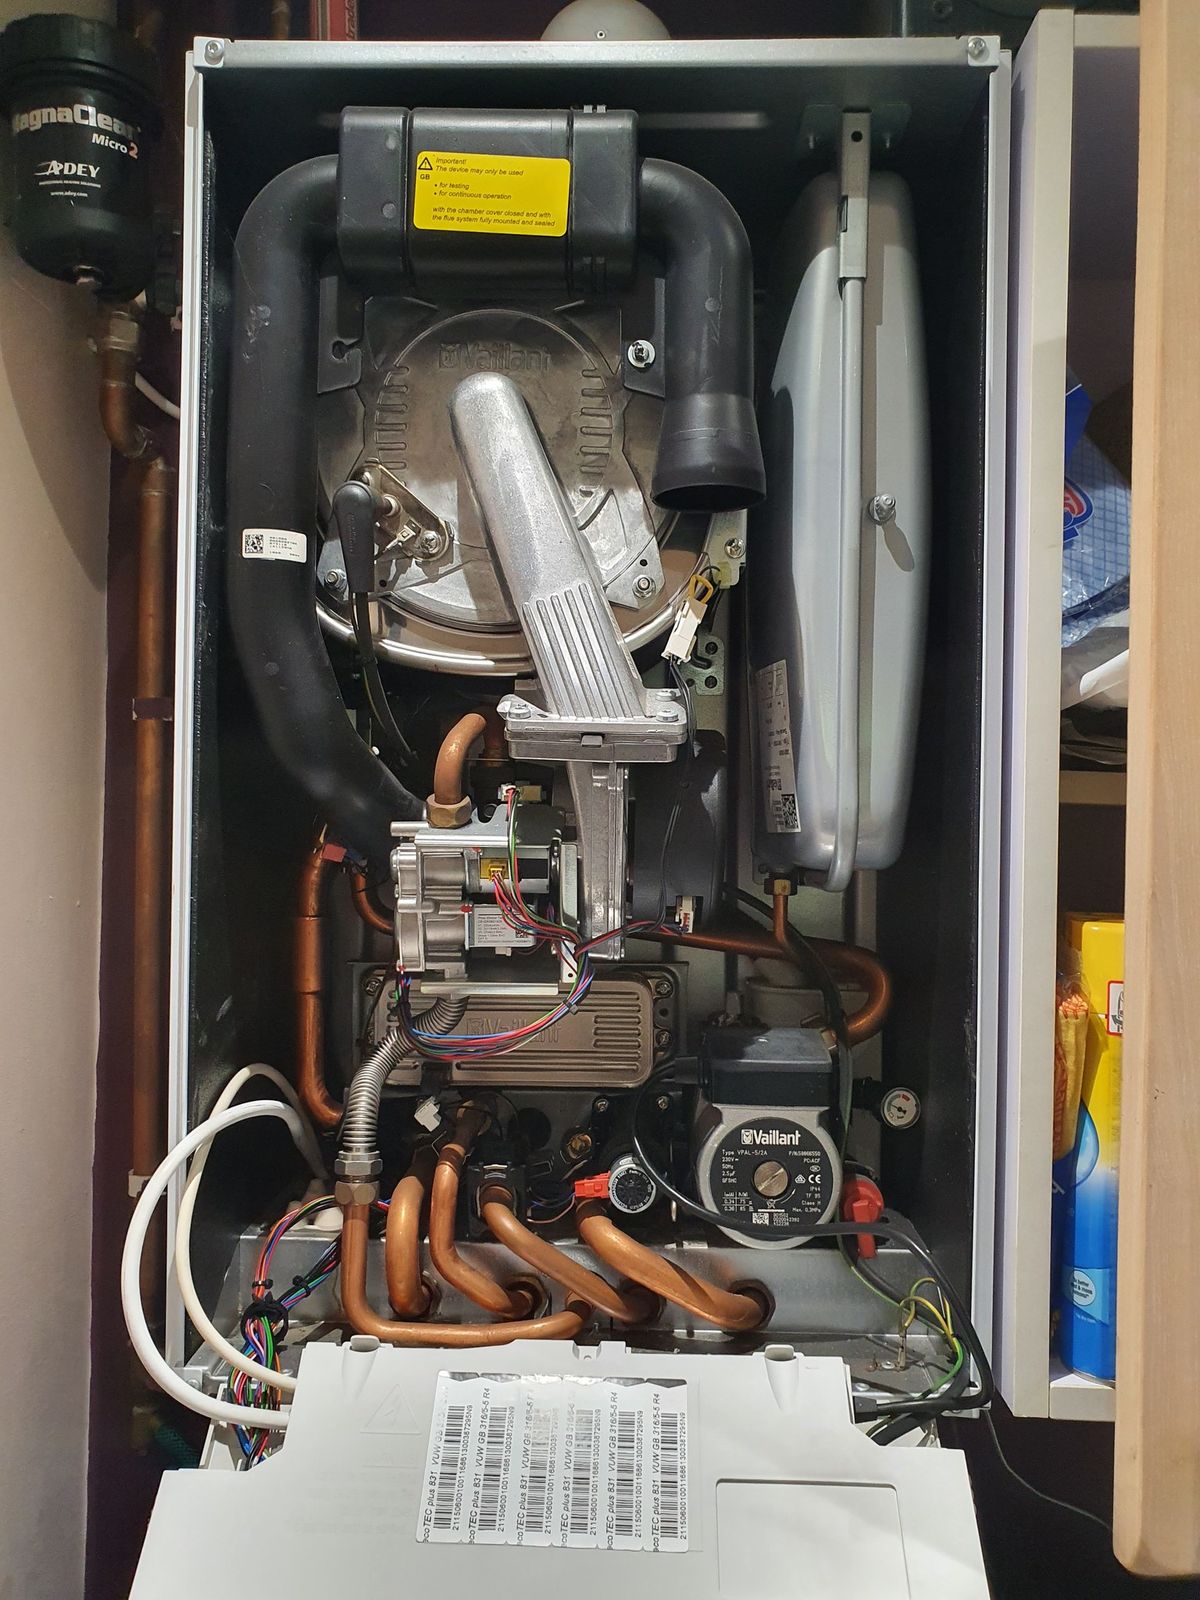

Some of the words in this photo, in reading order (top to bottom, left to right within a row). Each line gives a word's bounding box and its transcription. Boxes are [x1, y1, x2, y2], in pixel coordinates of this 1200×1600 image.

[47, 160, 100, 178] ADEY
[436, 157, 467, 165] Important!
[485, 168, 498, 176] only
[456, 216, 478, 224] system
[494, 217, 520, 225] mounted
[464, 343, 552, 370] Vaillant
[753, 1129, 801, 1146] Vaillant
[483, 1387, 490, 1399] R4
[611, 1391, 617, 1403] R4
[654, 1393, 660, 1404] R4
[480, 1400, 489, 1430] 316/5-5
[609, 1404, 617, 1434] 316/5-5
[653, 1406, 661, 1436] 316/5-5
[478, 1431, 486, 1444] GB
[566, 1434, 573, 1447] GB
[608, 1436, 616, 1449] GB
[653, 1438, 660, 1450] GB
[431, 1444, 440, 1465] VUW
[475, 1446, 484, 1467] VUW
[521, 1447, 530, 1469] VUW
[564, 1449, 572, 1470] VUW
[652, 1452, 660, 1474] VUW
[428, 1471, 438, 1486] 831
[474, 1473, 482, 1487] 831
[520, 1475, 528, 1490] 831
[562, 1476, 571, 1491] 831
[607, 1477, 615, 1493] 831
[652, 1479, 660, 1495] 831
[427, 1488, 436, 1506] plus
[472, 1490, 480, 1508] plus
[519, 1492, 528, 1510] plus
[562, 1493, 570, 1512] plus
[607, 1495, 615, 1513] plus
[652, 1497, 660, 1515] plus
